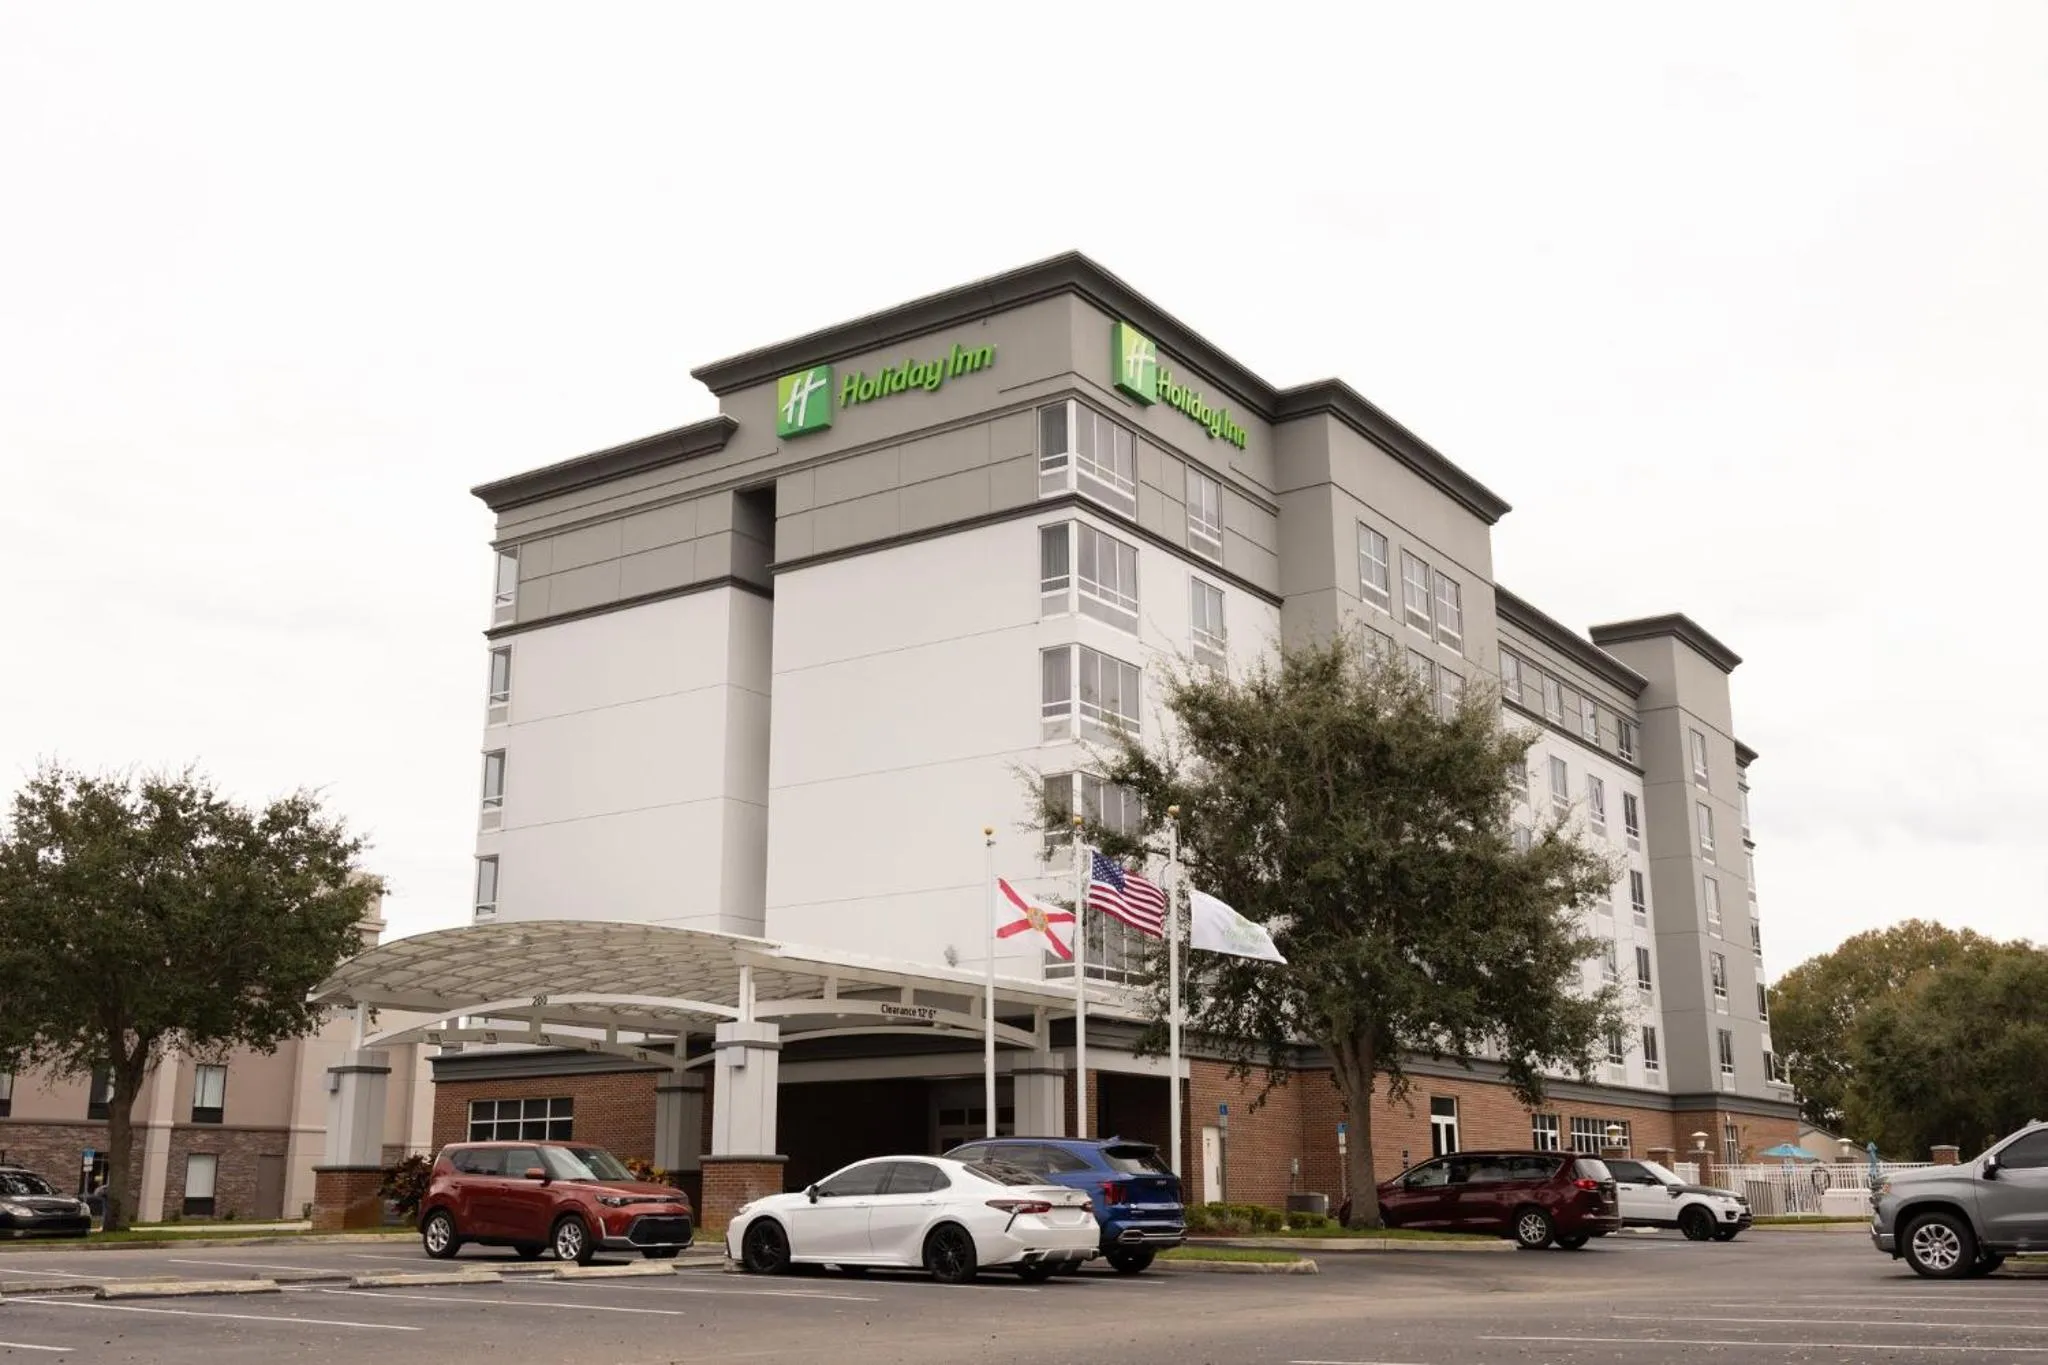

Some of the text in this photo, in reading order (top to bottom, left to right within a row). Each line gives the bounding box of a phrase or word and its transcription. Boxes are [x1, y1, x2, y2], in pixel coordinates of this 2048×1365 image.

[839, 343, 995, 408] Holiday Inn
[1156, 366, 1247, 449] Holiday Inn
[881, 1004, 917, 1016] Clearance
